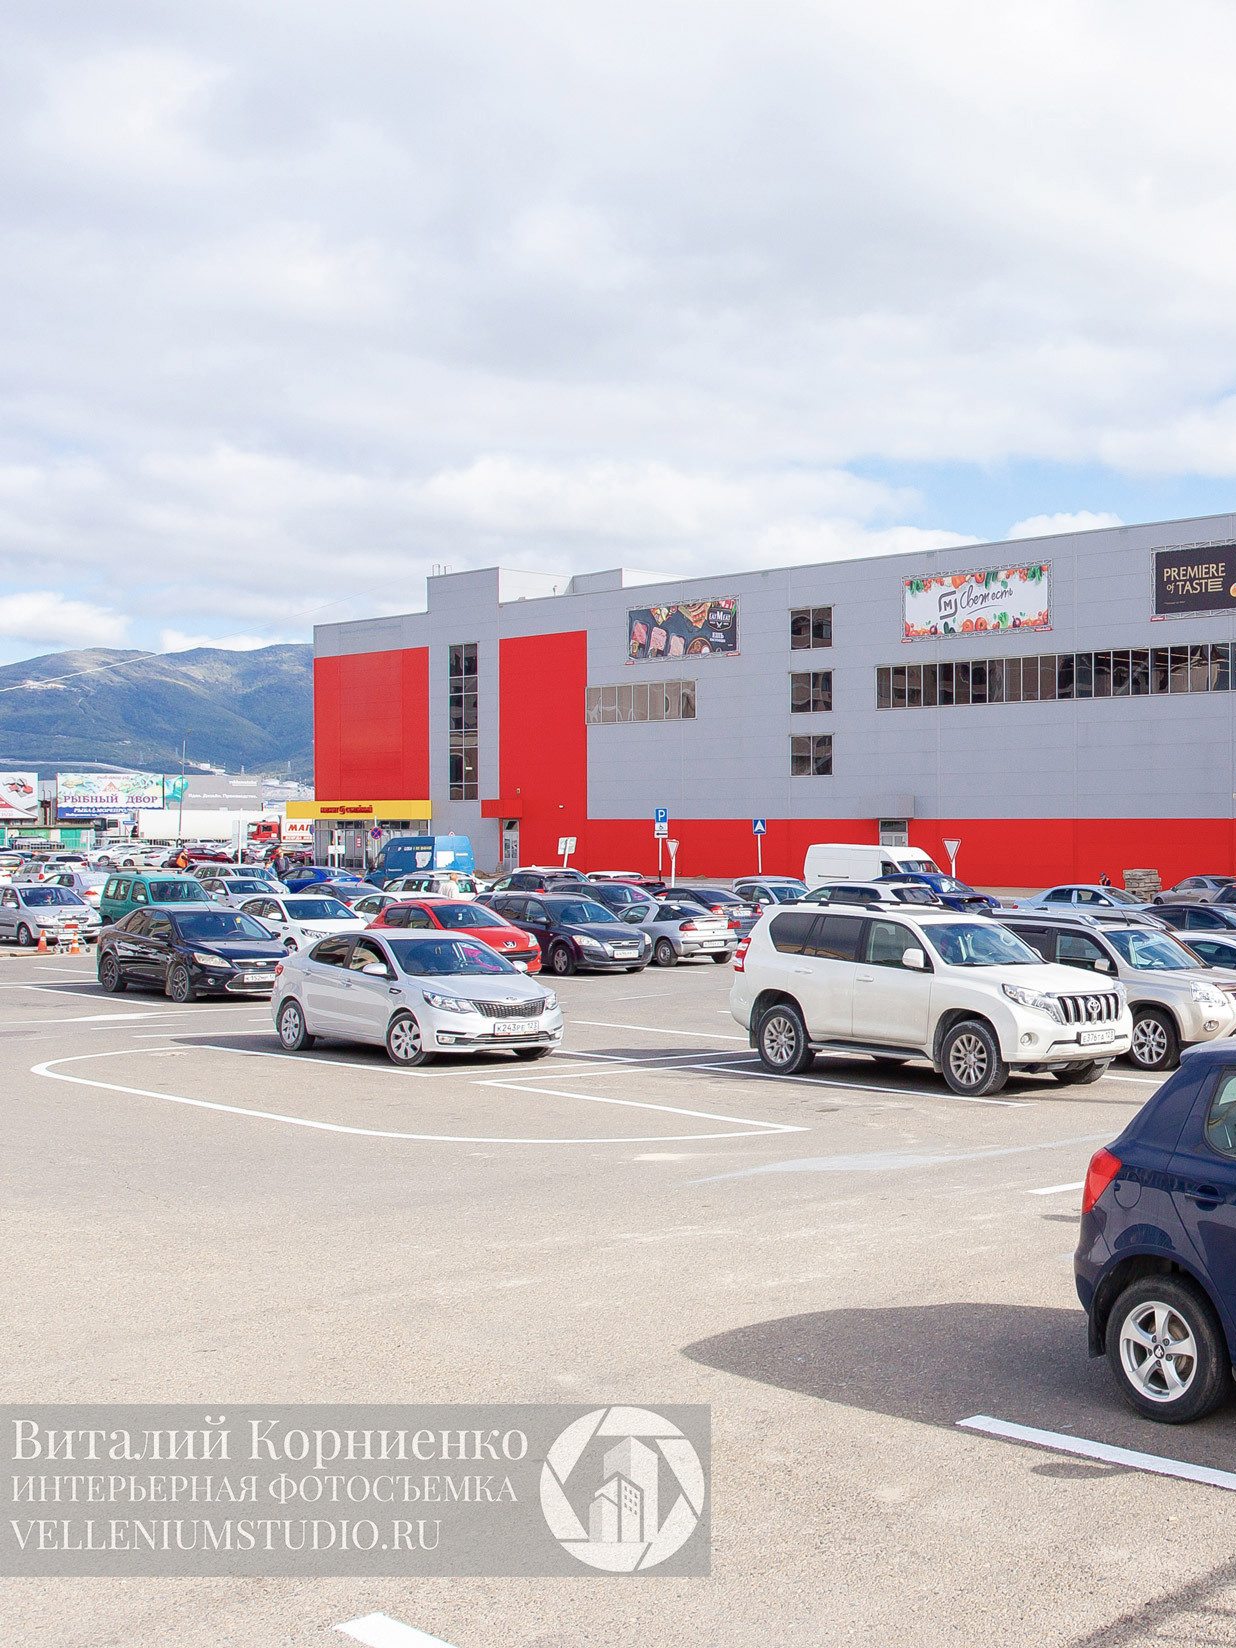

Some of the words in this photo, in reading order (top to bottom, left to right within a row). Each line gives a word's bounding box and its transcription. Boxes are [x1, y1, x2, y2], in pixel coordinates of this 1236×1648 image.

[1163, 562, 1226, 581] PREMIERE
[1166, 583, 1175, 594] of
[1177, 578, 1224, 595] TASTE
[64, 794, 118, 803] РЫБНЫЙ
[126, 796, 158, 804] ДВОР
